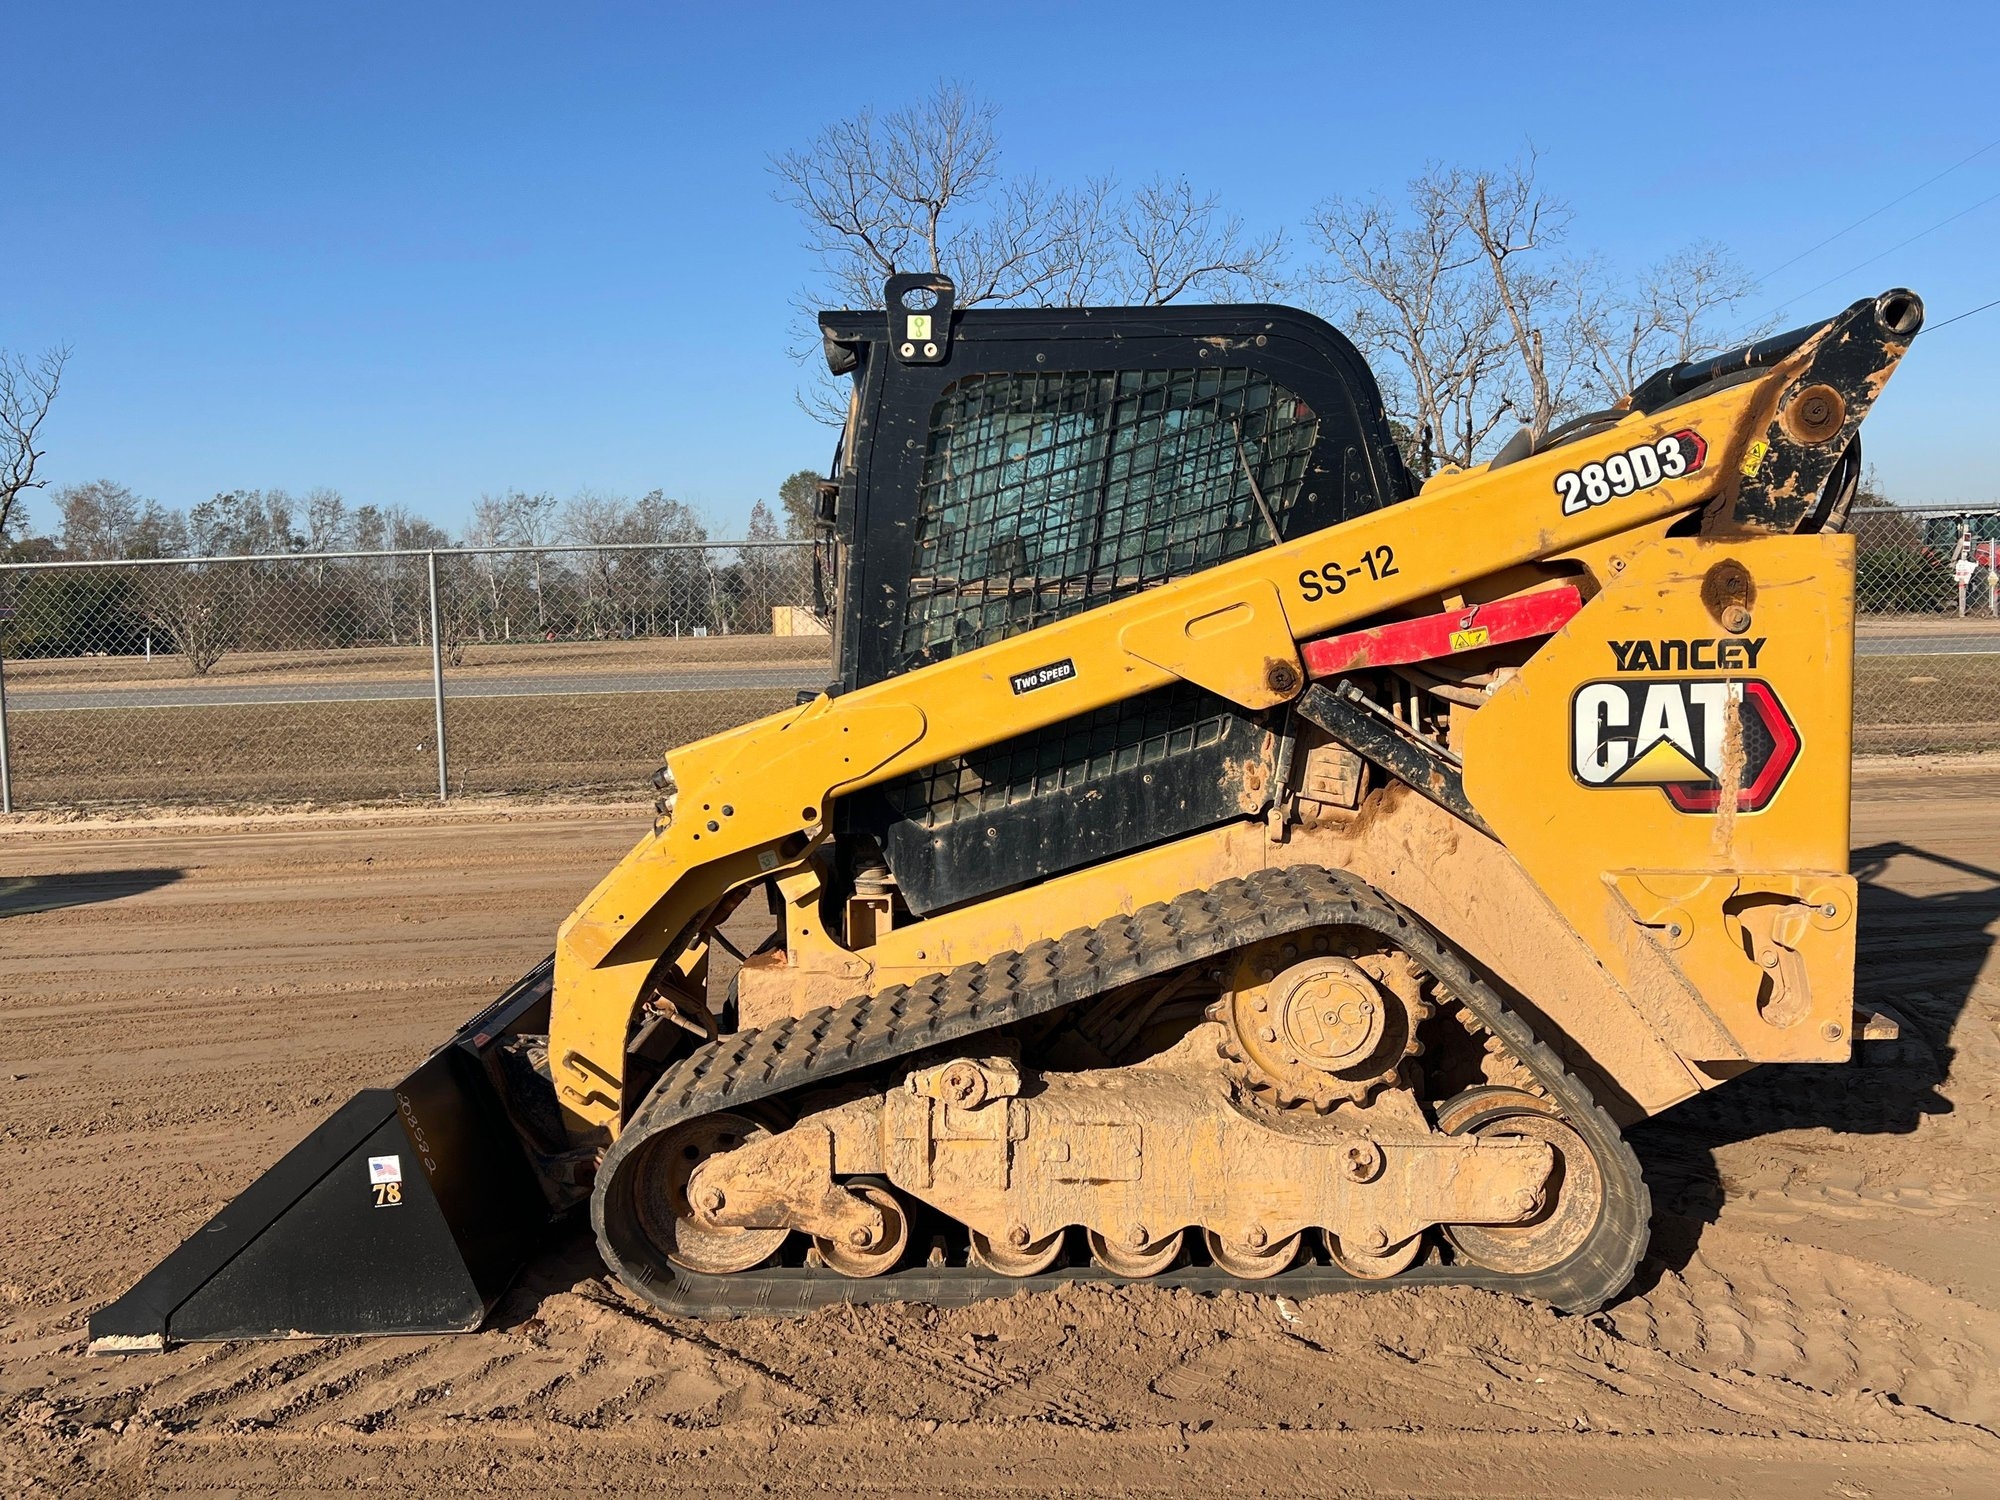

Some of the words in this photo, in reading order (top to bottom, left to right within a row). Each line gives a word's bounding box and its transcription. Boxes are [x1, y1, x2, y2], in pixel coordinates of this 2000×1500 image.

[1556, 436, 1687, 514] 289D3
[1298, 545, 1400, 602] SS-12
[1607, 637, 1768, 671] YANCEY
[1575, 682, 1744, 784] CAT
